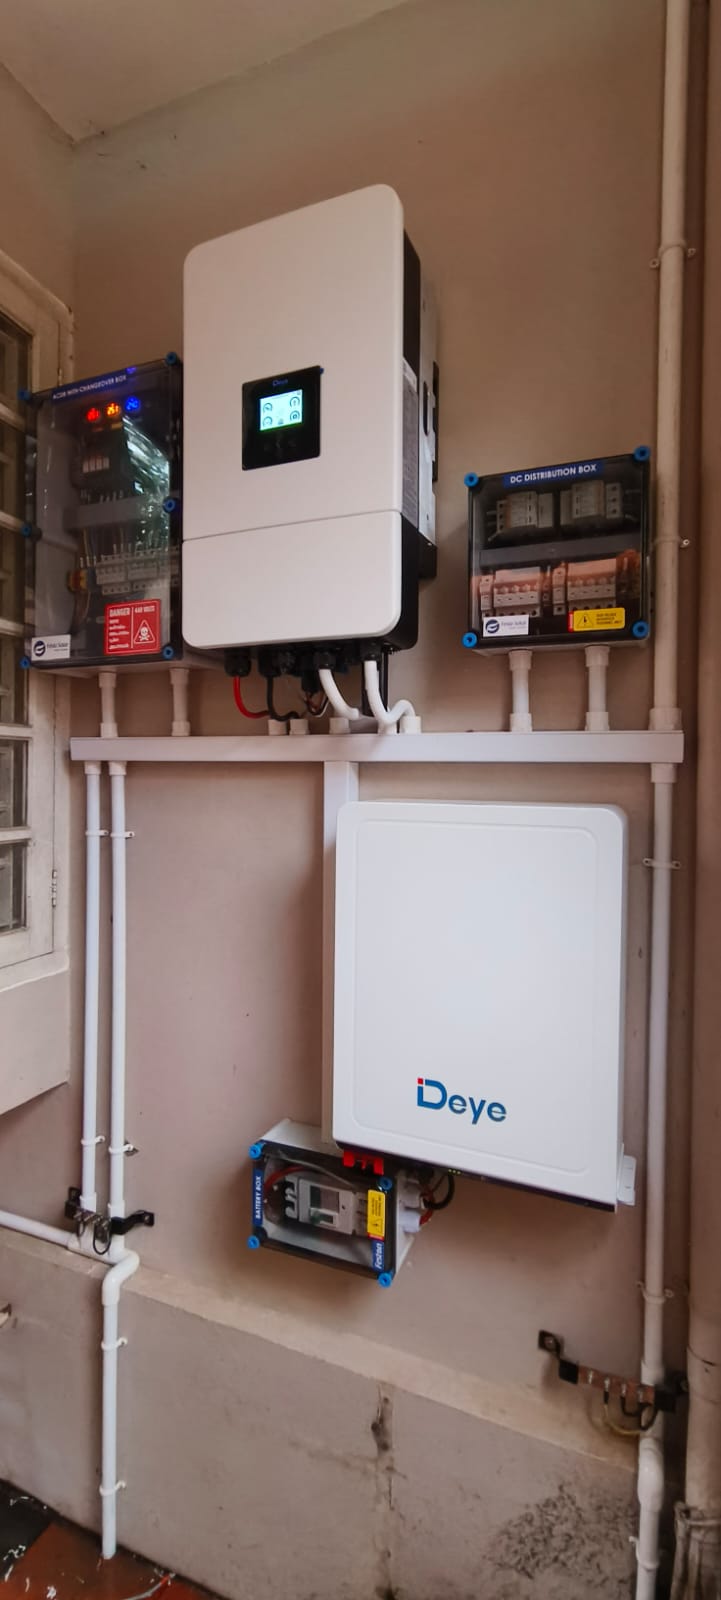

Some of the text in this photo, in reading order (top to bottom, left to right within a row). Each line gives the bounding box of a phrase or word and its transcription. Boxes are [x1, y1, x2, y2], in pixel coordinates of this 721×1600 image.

[510, 463, 597, 484] DC DISTRIBUTION BOX
[109, 607, 131, 617] DANGER
